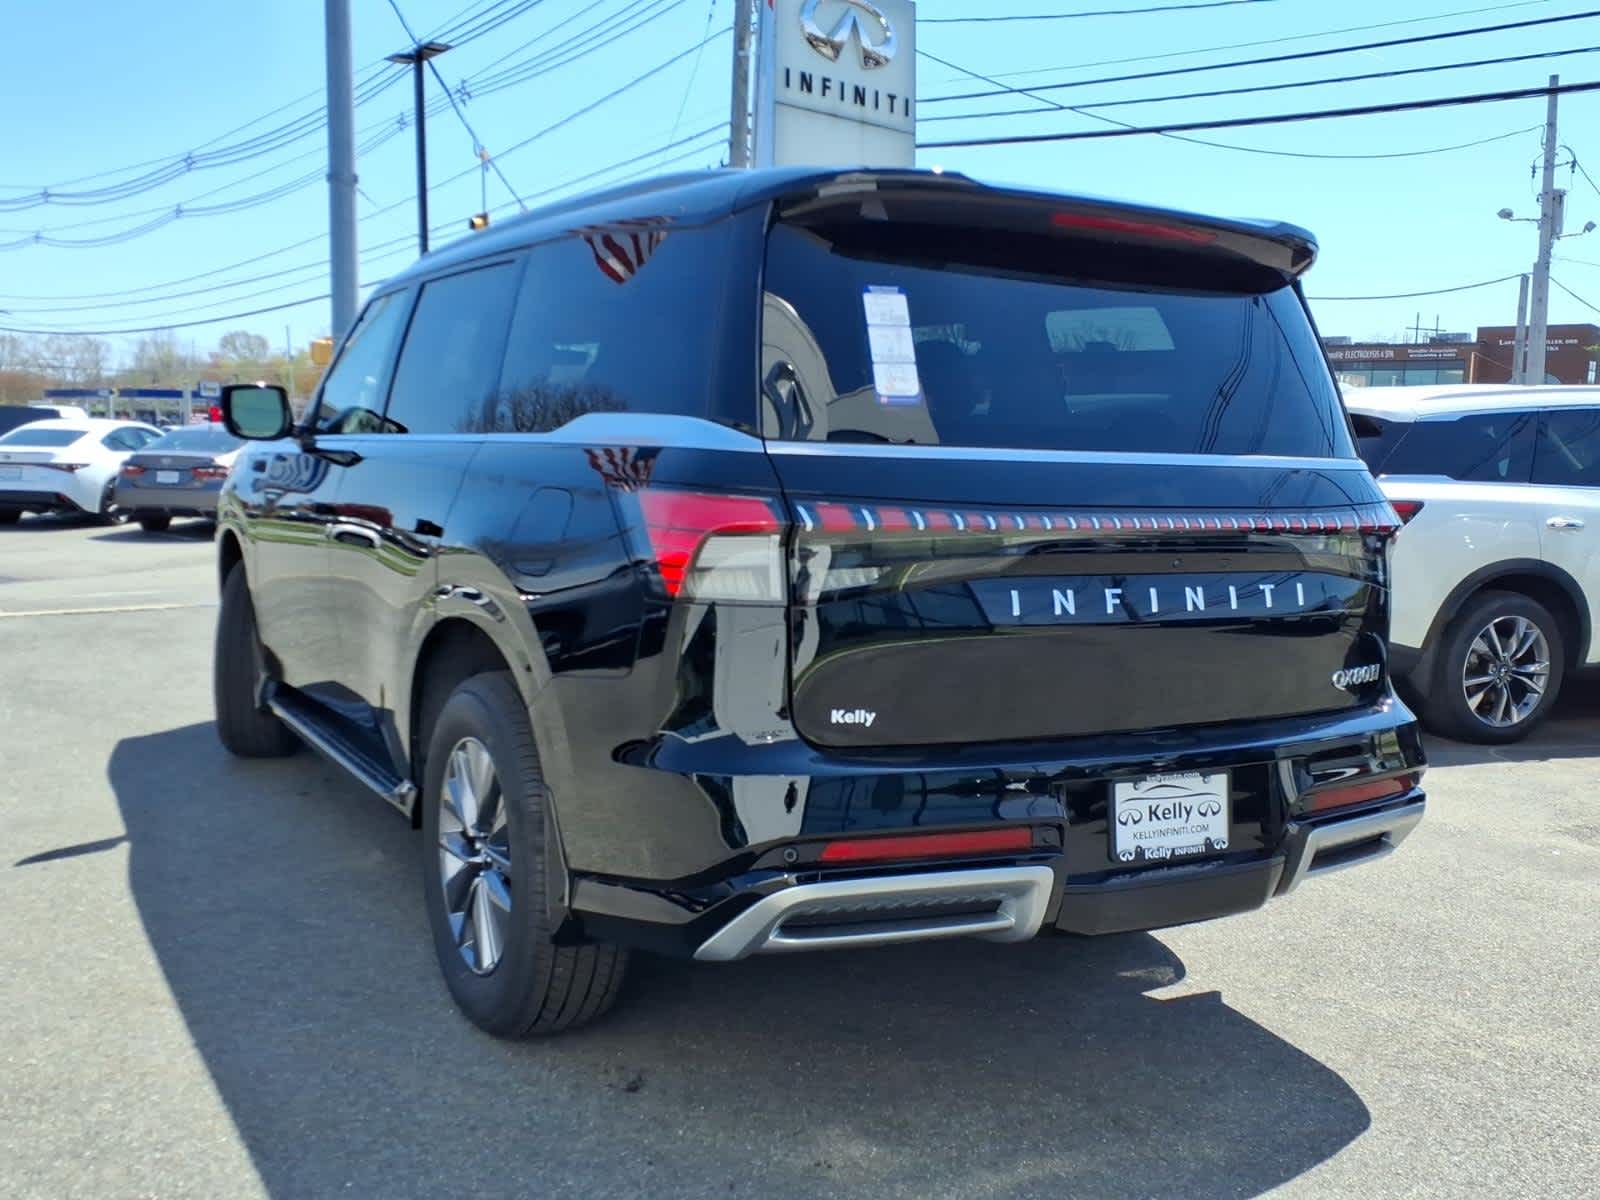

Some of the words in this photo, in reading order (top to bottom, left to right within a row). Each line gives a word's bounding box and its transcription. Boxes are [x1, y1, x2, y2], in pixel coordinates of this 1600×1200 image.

[785, 67, 910, 117] INFINITI
[1010, 582, 1305, 617] INFINITI
[831, 708, 877, 728] Kelly
[1148, 802, 1193, 824] Kelly
[1133, 823, 1209, 841] KELLYINFINITI.COM
[1144, 845, 1173, 860] Kelly
[1174, 845, 1205, 856] INFINITI
